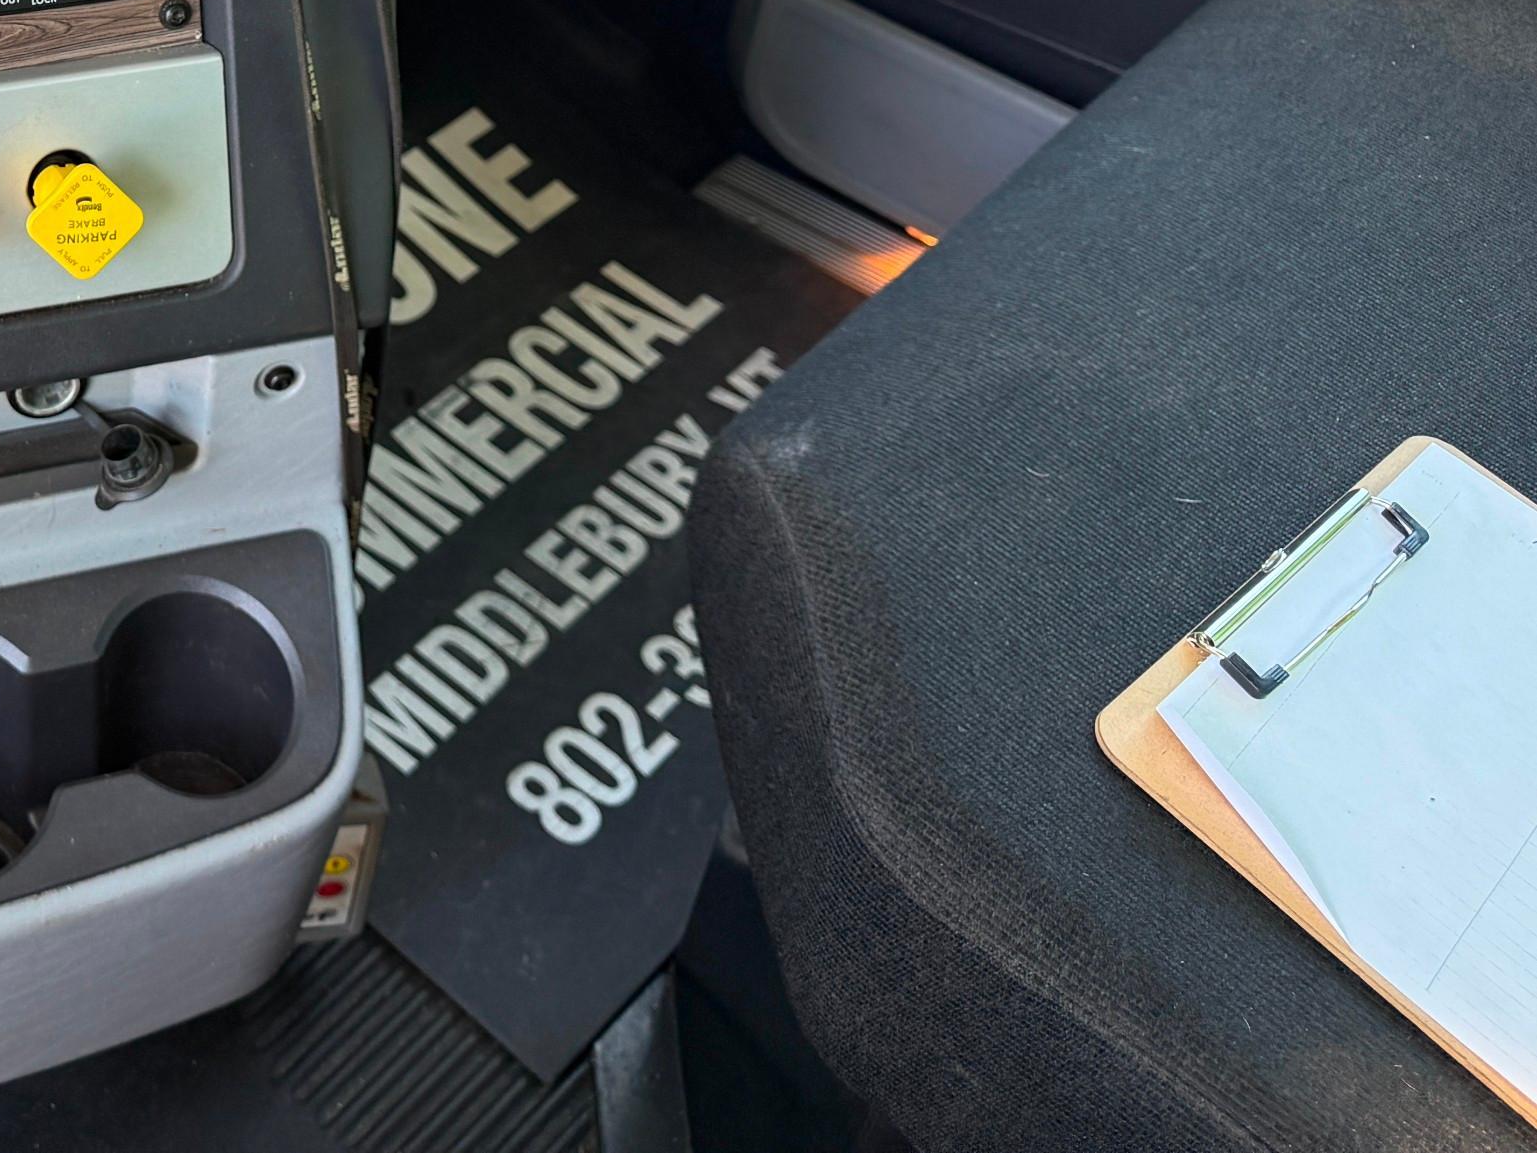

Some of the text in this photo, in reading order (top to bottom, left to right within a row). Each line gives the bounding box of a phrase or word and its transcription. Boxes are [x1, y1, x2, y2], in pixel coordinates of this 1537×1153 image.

[97, 181, 115, 198] PUSH
[77, 203, 102, 212] Bendix
[68, 217, 106, 229] BRAKE
[56, 230, 117, 245] PARKING
[57, 248, 113, 273] PULL TO APPLY
[352, 259, 726, 620] MMERCIAL
[505, 602, 713, 846] 802-3
